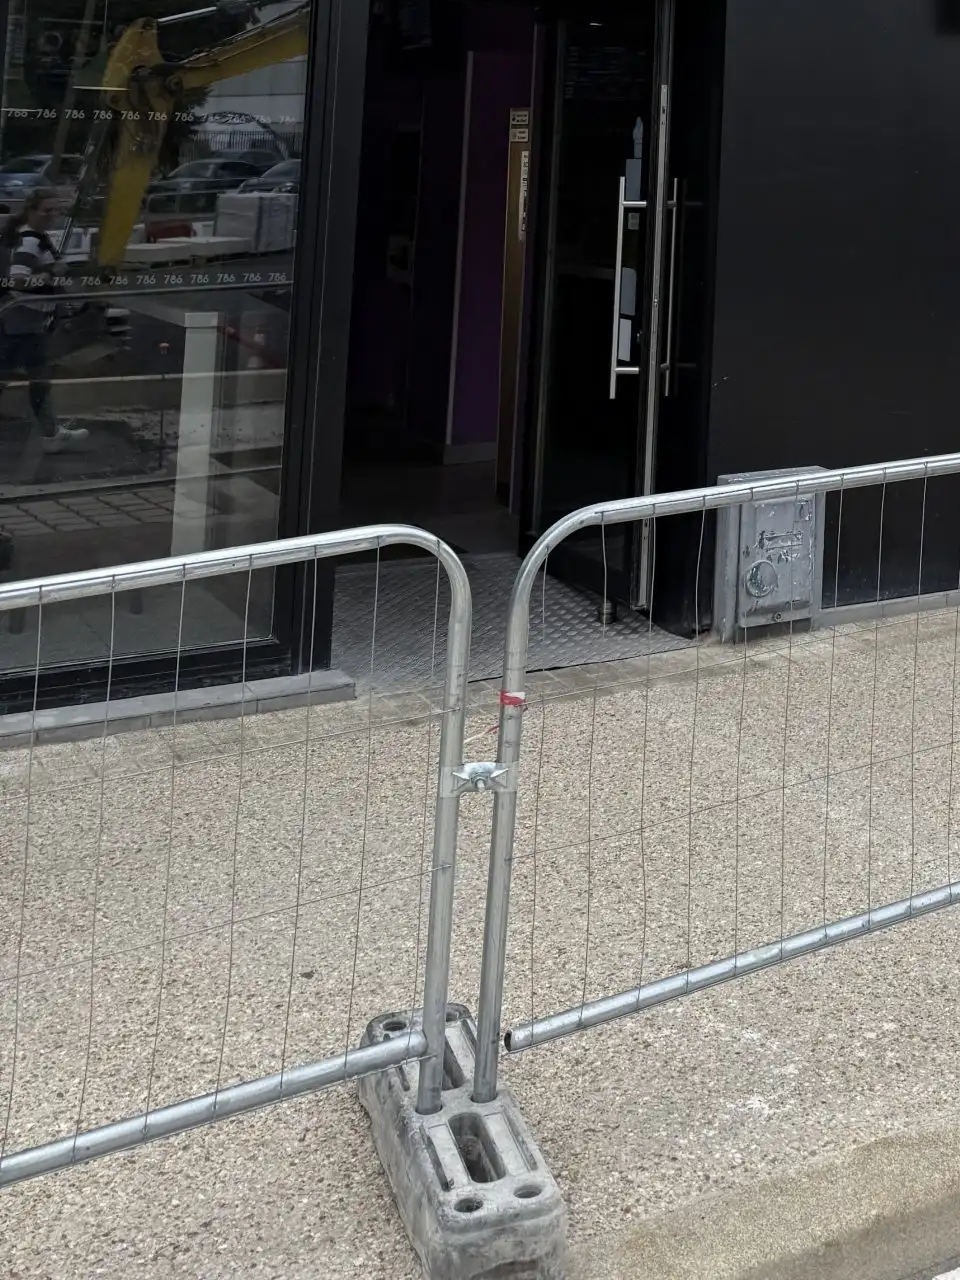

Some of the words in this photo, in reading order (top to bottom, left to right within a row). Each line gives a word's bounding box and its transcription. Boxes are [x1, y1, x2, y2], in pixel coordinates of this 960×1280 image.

[36, 109, 57, 119] 786
[65, 109, 86, 119] 786
[93, 110, 113, 120] 786
[120, 110, 140, 120] 786
[147, 111, 167, 121] 786
[175, 112, 194, 122] 786
[24, 278, 45, 287] 786
[53, 277, 73, 287] 786
[81, 276, 101, 286] 786
[109, 276, 129, 285] 786
[136, 275, 156, 285] 786
[163, 274, 183, 284] 786
[190, 274, 209, 283] 786
[217, 273, 236, 283] 786
[243, 273, 261, 282] 786
[268, 272, 287, 282] 786
